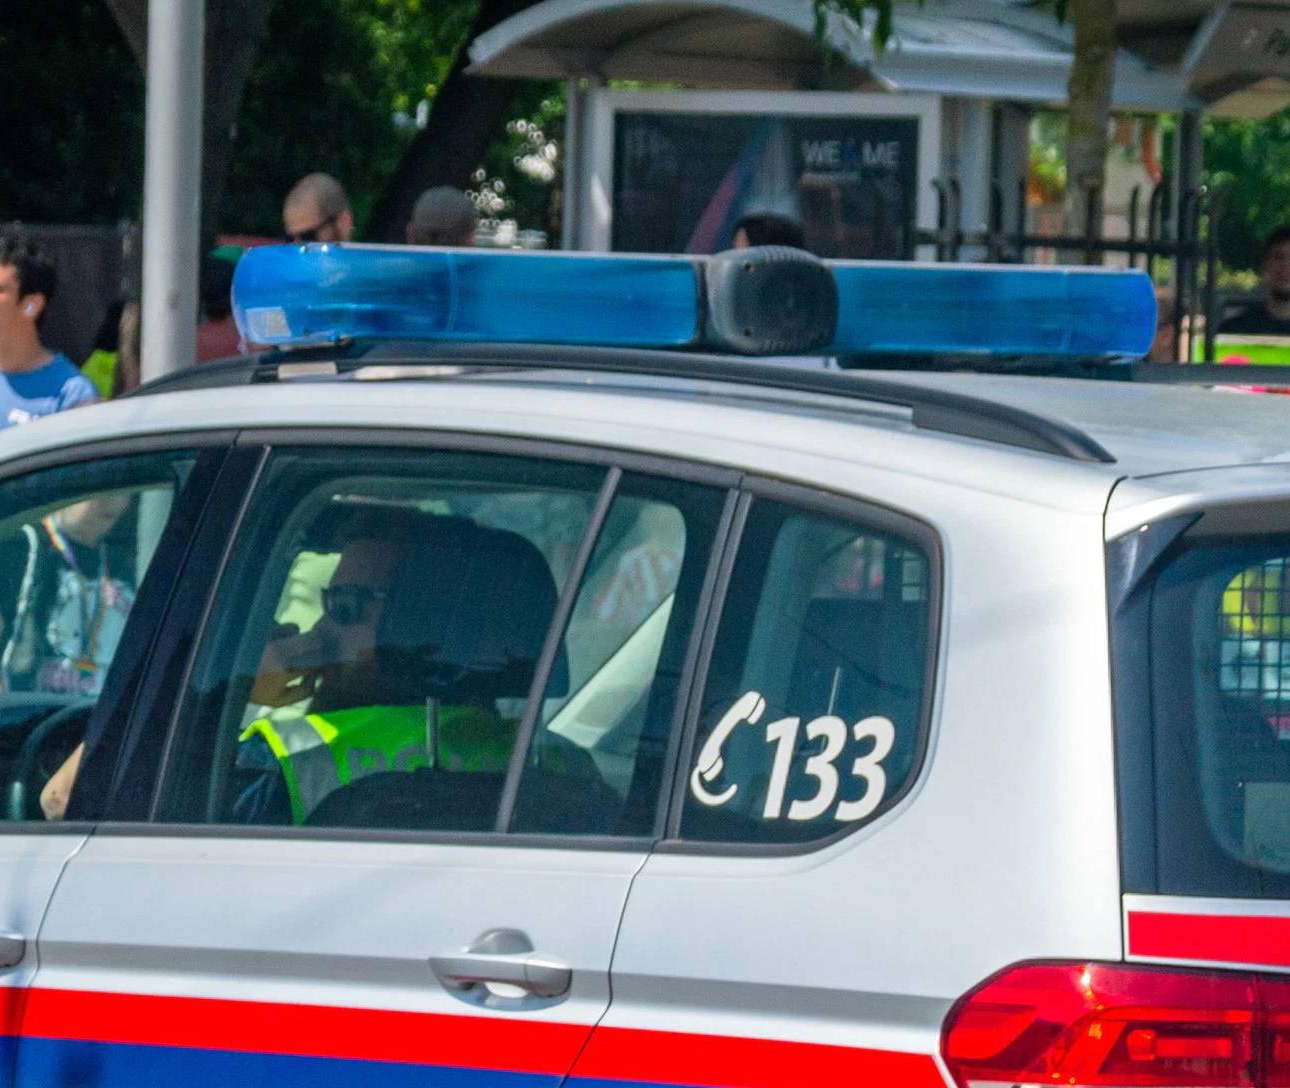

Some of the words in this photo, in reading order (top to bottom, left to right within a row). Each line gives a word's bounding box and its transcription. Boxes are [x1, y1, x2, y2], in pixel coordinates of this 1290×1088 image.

[802, 140, 841, 164] WE
[862, 141, 900, 166] ME
[763, 715, 895, 821] 133
